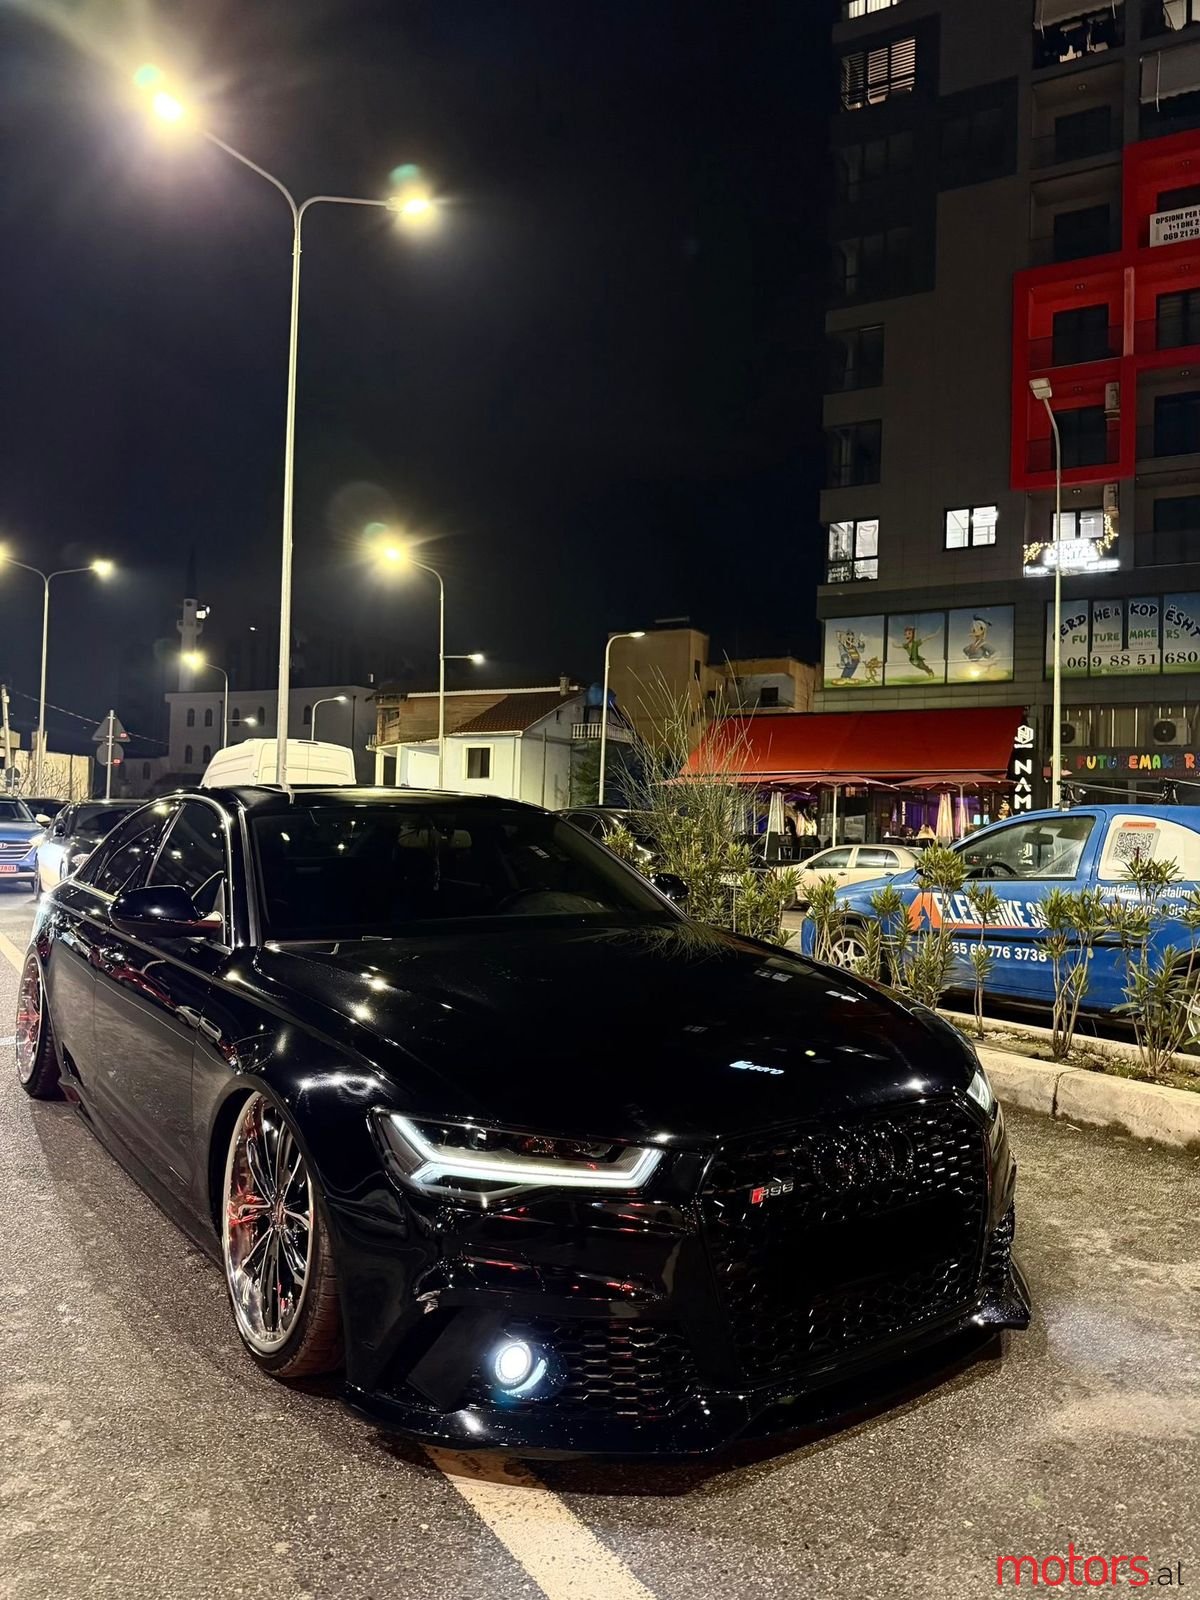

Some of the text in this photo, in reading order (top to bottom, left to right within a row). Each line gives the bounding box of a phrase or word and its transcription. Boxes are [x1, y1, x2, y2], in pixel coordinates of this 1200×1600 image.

[1156, 210, 1198, 224] OPSIONE PER
[1180, 220, 1193, 228] DHE
[1163, 232, 1179, 240] 069
[1179, 230, 1189, 238] 21
[1066, 650, 1199, 669] 069 88 51 680
[1013, 758, 1033, 815] NAM
[988, 945, 1011, 959] 776
